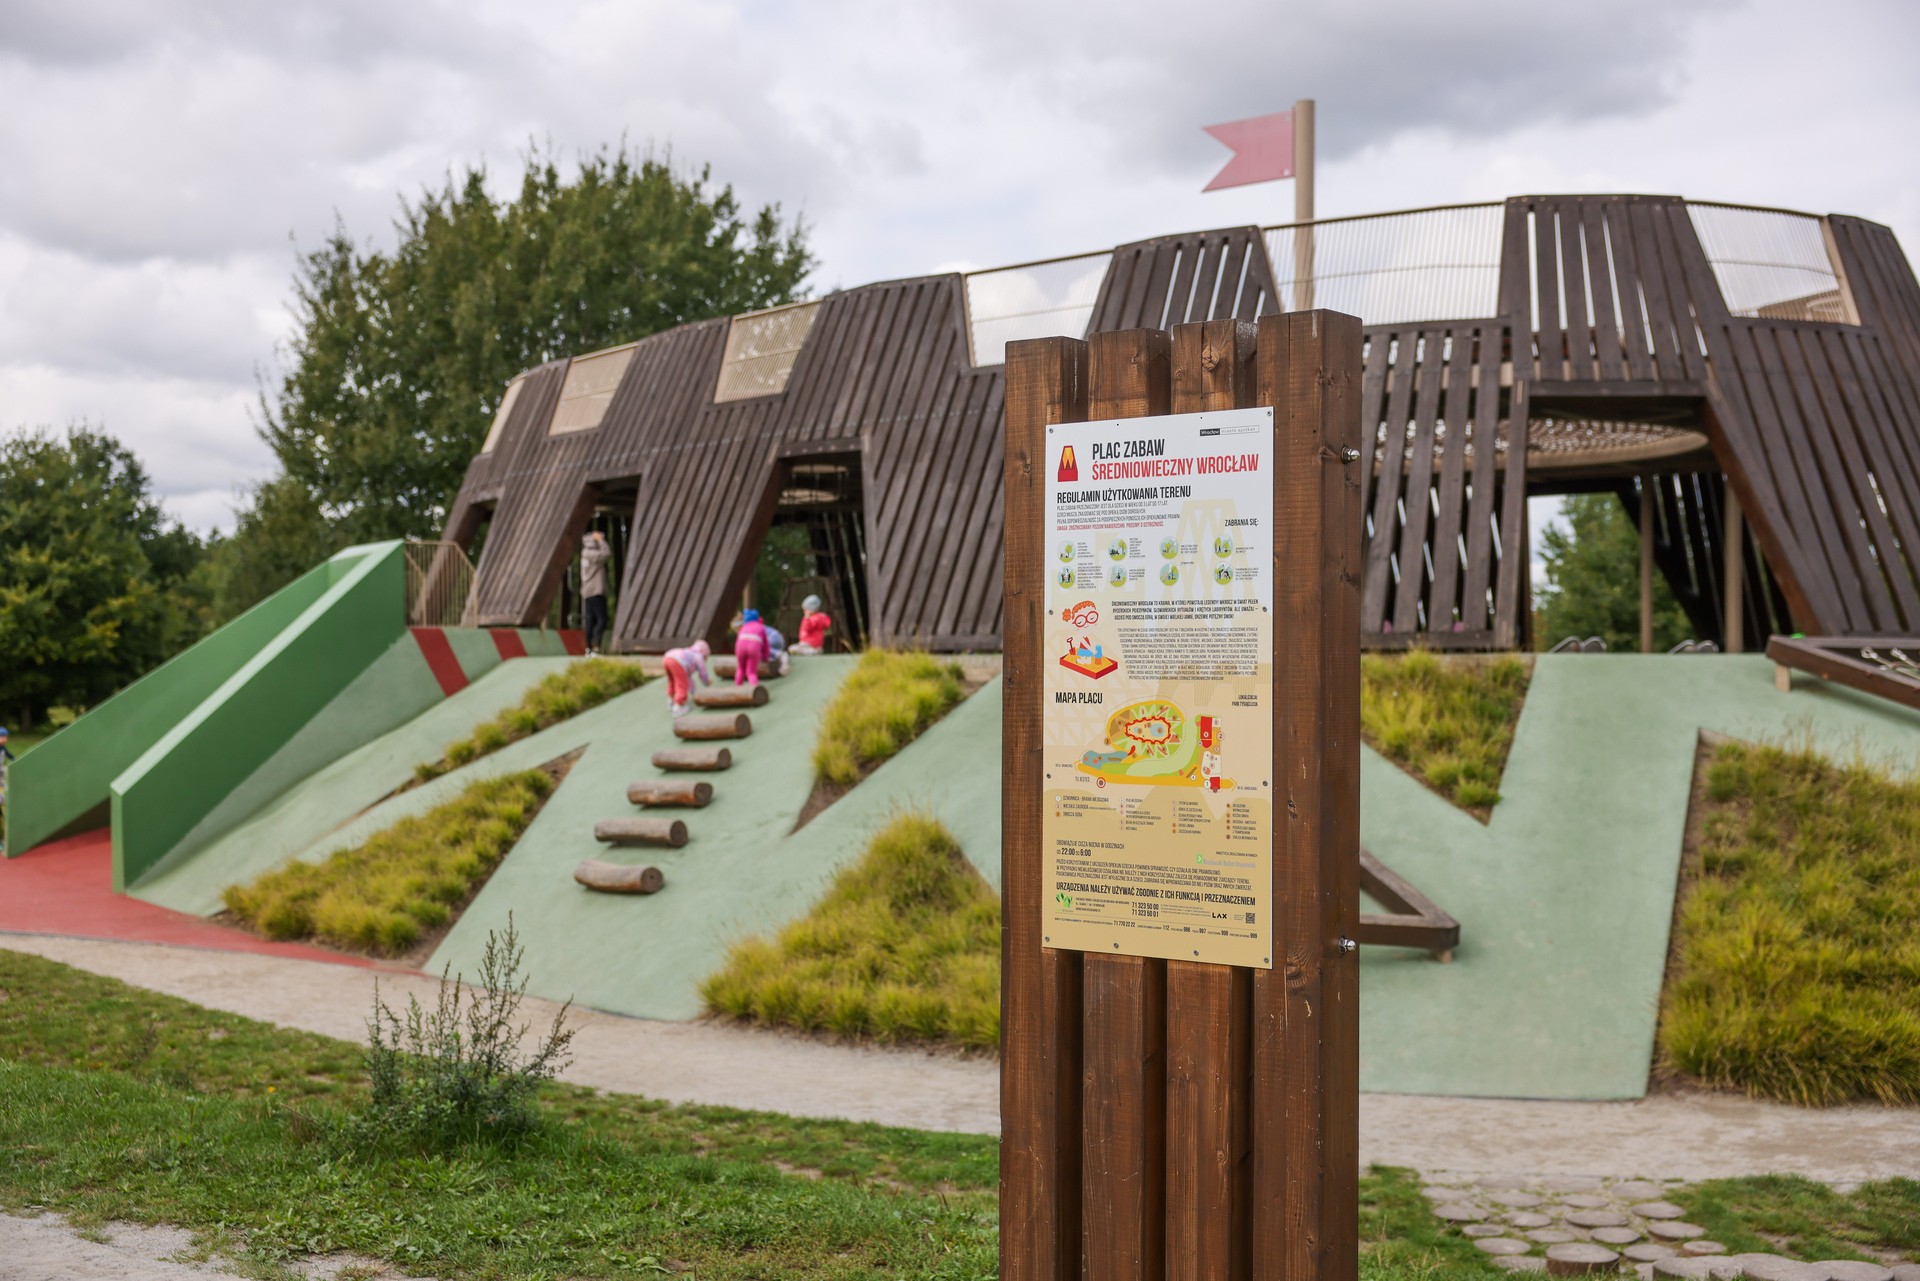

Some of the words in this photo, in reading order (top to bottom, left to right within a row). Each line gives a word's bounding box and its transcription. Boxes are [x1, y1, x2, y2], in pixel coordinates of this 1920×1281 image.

[1092, 442, 1120, 460] PLAC
[1124, 439, 1164, 458] ZABAW
[1092, 458, 1193, 480] ŚREDNIOWIECZNY
[1197, 454, 1259, 474] WROCŁAW
[1058, 491, 1100, 503] REGULAMIN
[1103, 487, 1157, 501] UŻYTKOWANIA
[1160, 486, 1191, 498] TERENU
[1056, 692, 1077, 703] MAPA
[1079, 693, 1102, 704] PLACU
[1056, 882, 1089, 892] URZĄDZENIA
[1090, 884, 1111, 894] NALEŻY
[1112, 885, 1135, 896] UŻYWAĆ
[1136, 888, 1158, 897] ZGODNIE
[1160, 890, 1164, 898] Z
[1165, 890, 1174, 899] ICH
[1176, 891, 1200, 903] FUNKCJĄ
[1201, 893, 1203, 901] I
[1205, 893, 1255, 905] PRZEZNACZENIEM
